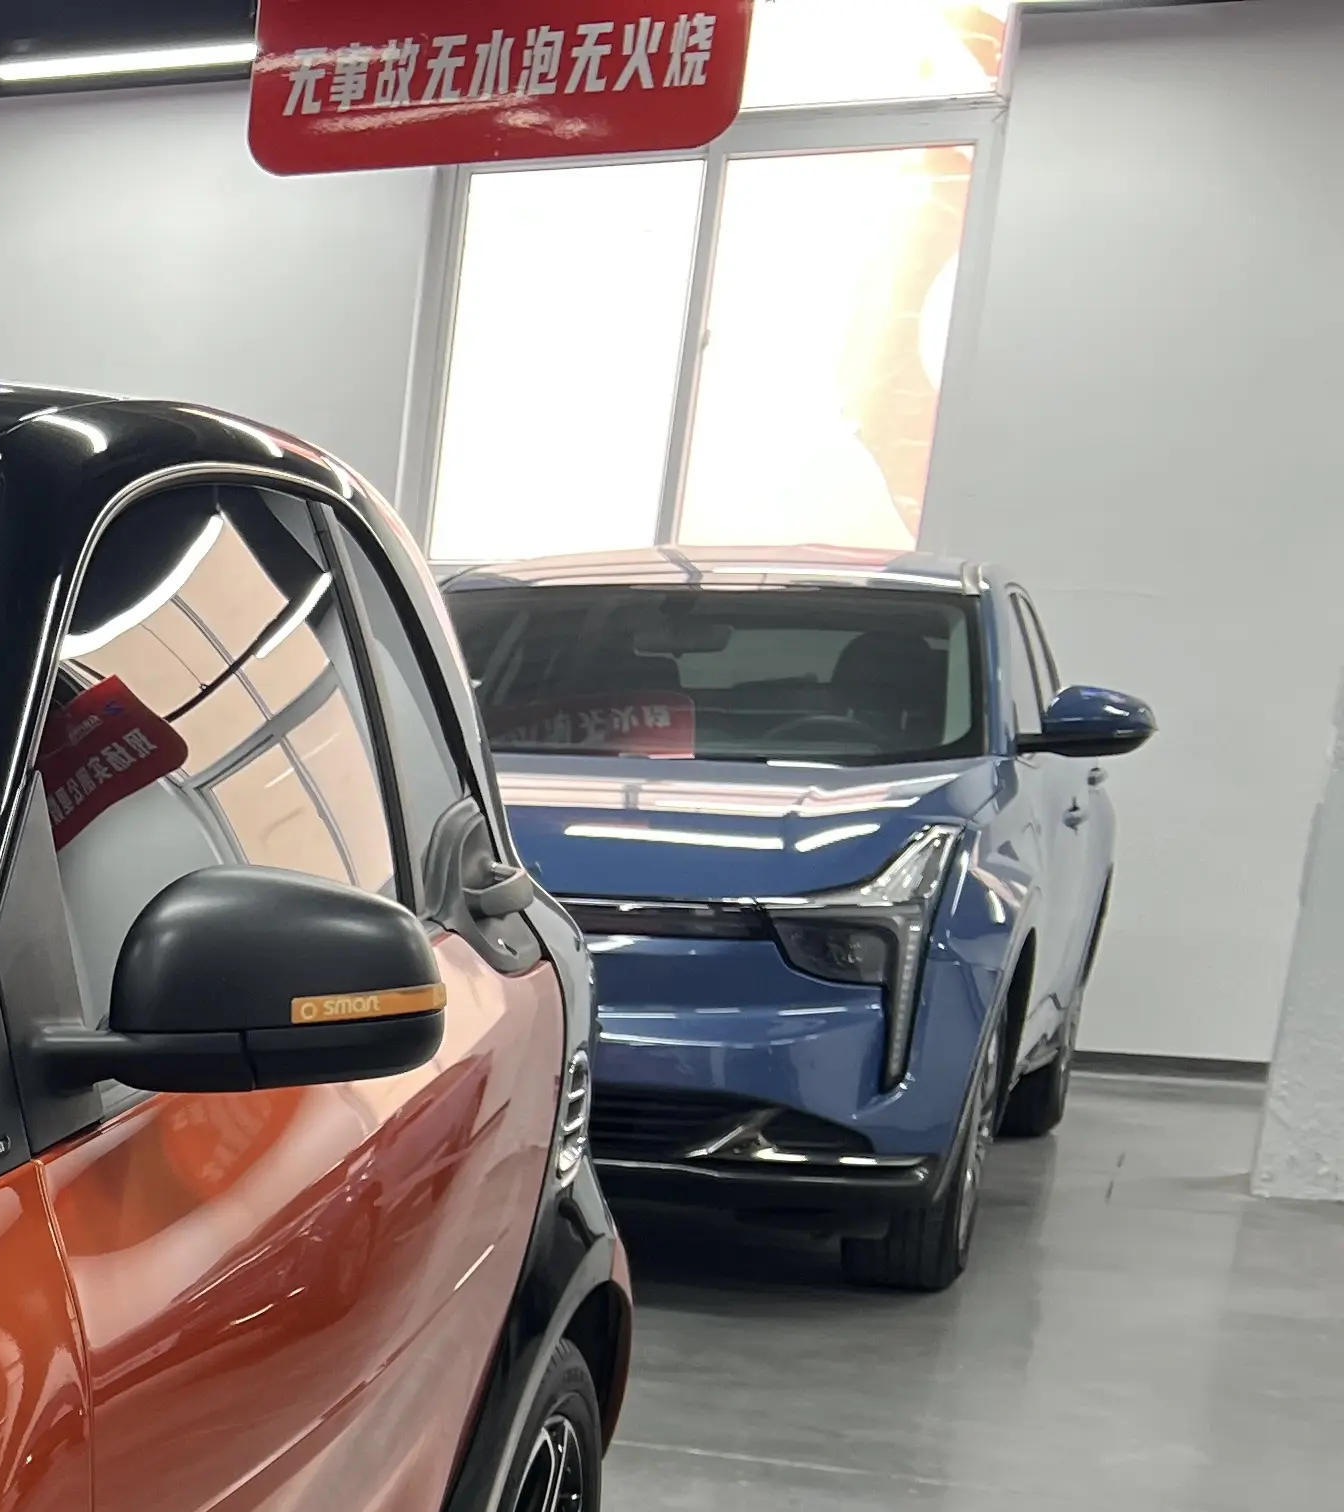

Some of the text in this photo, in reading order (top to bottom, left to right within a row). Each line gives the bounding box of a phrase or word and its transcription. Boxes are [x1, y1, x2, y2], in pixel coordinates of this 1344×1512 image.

[282, 12, 718, 117] 无事故无水泡无火烧
[323, 995, 381, 1016] smart
